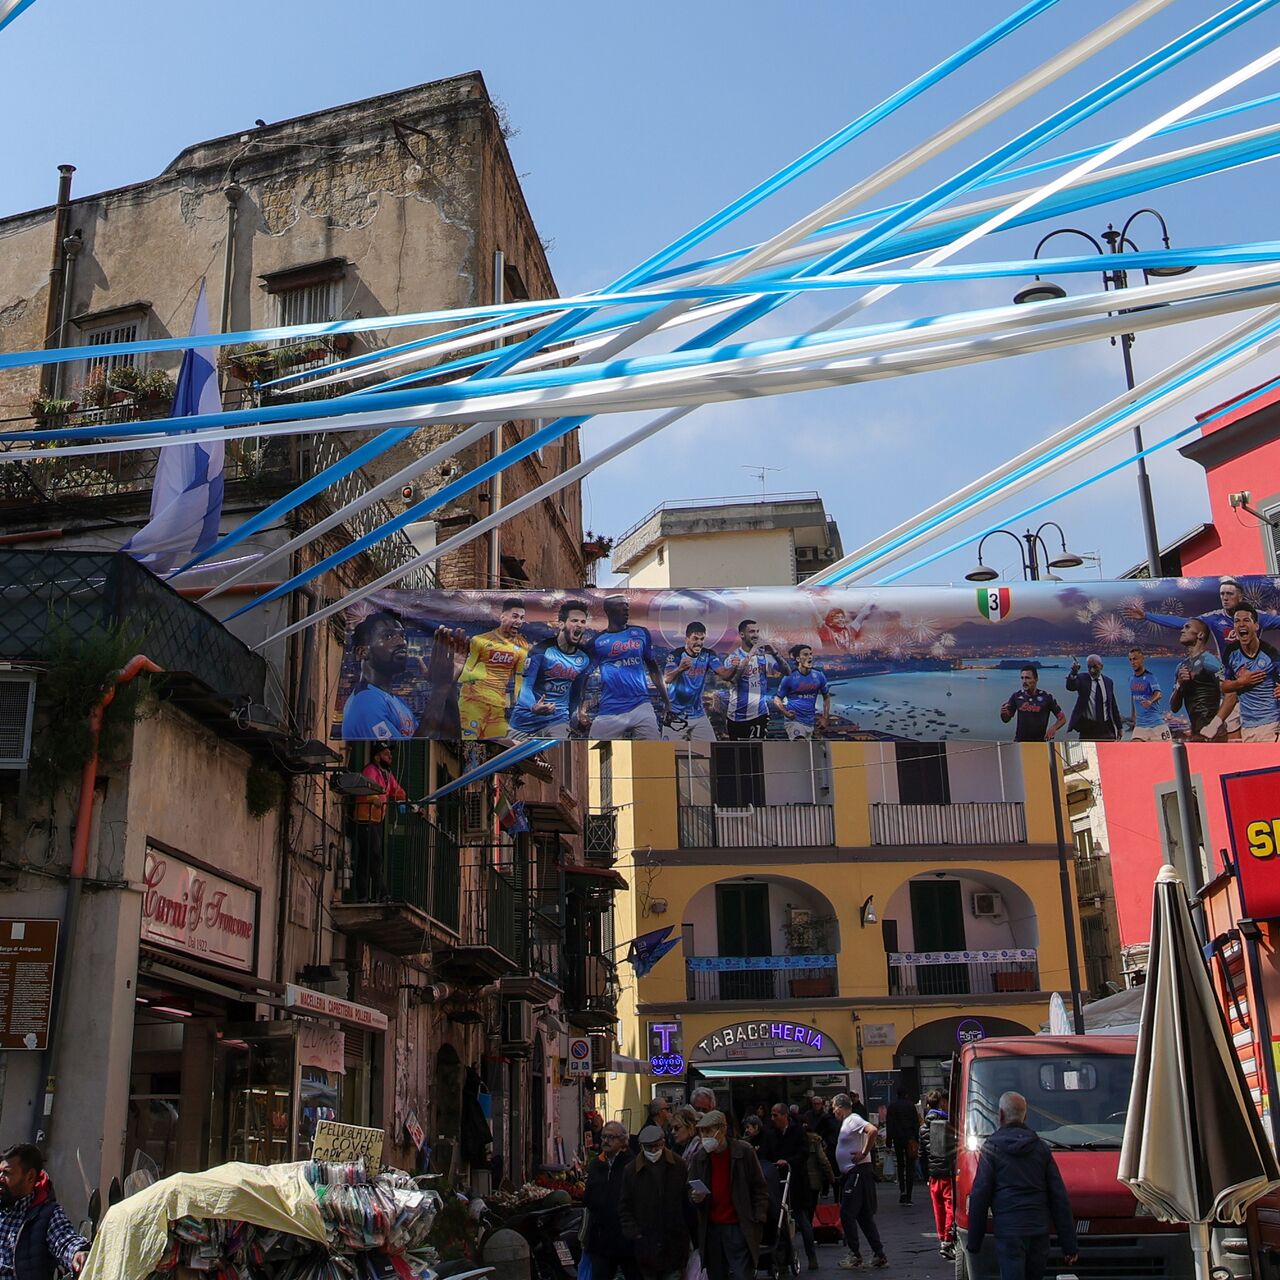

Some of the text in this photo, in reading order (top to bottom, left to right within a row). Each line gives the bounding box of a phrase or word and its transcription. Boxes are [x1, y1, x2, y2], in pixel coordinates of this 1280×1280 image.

[989, 593, 999, 611] 3
[490, 651, 514, 663] Lete
[622, 656, 641, 666] MSC
[698, 1022, 823, 1056] TABACCHERIA
[332, 1137, 374, 1153] COVER
